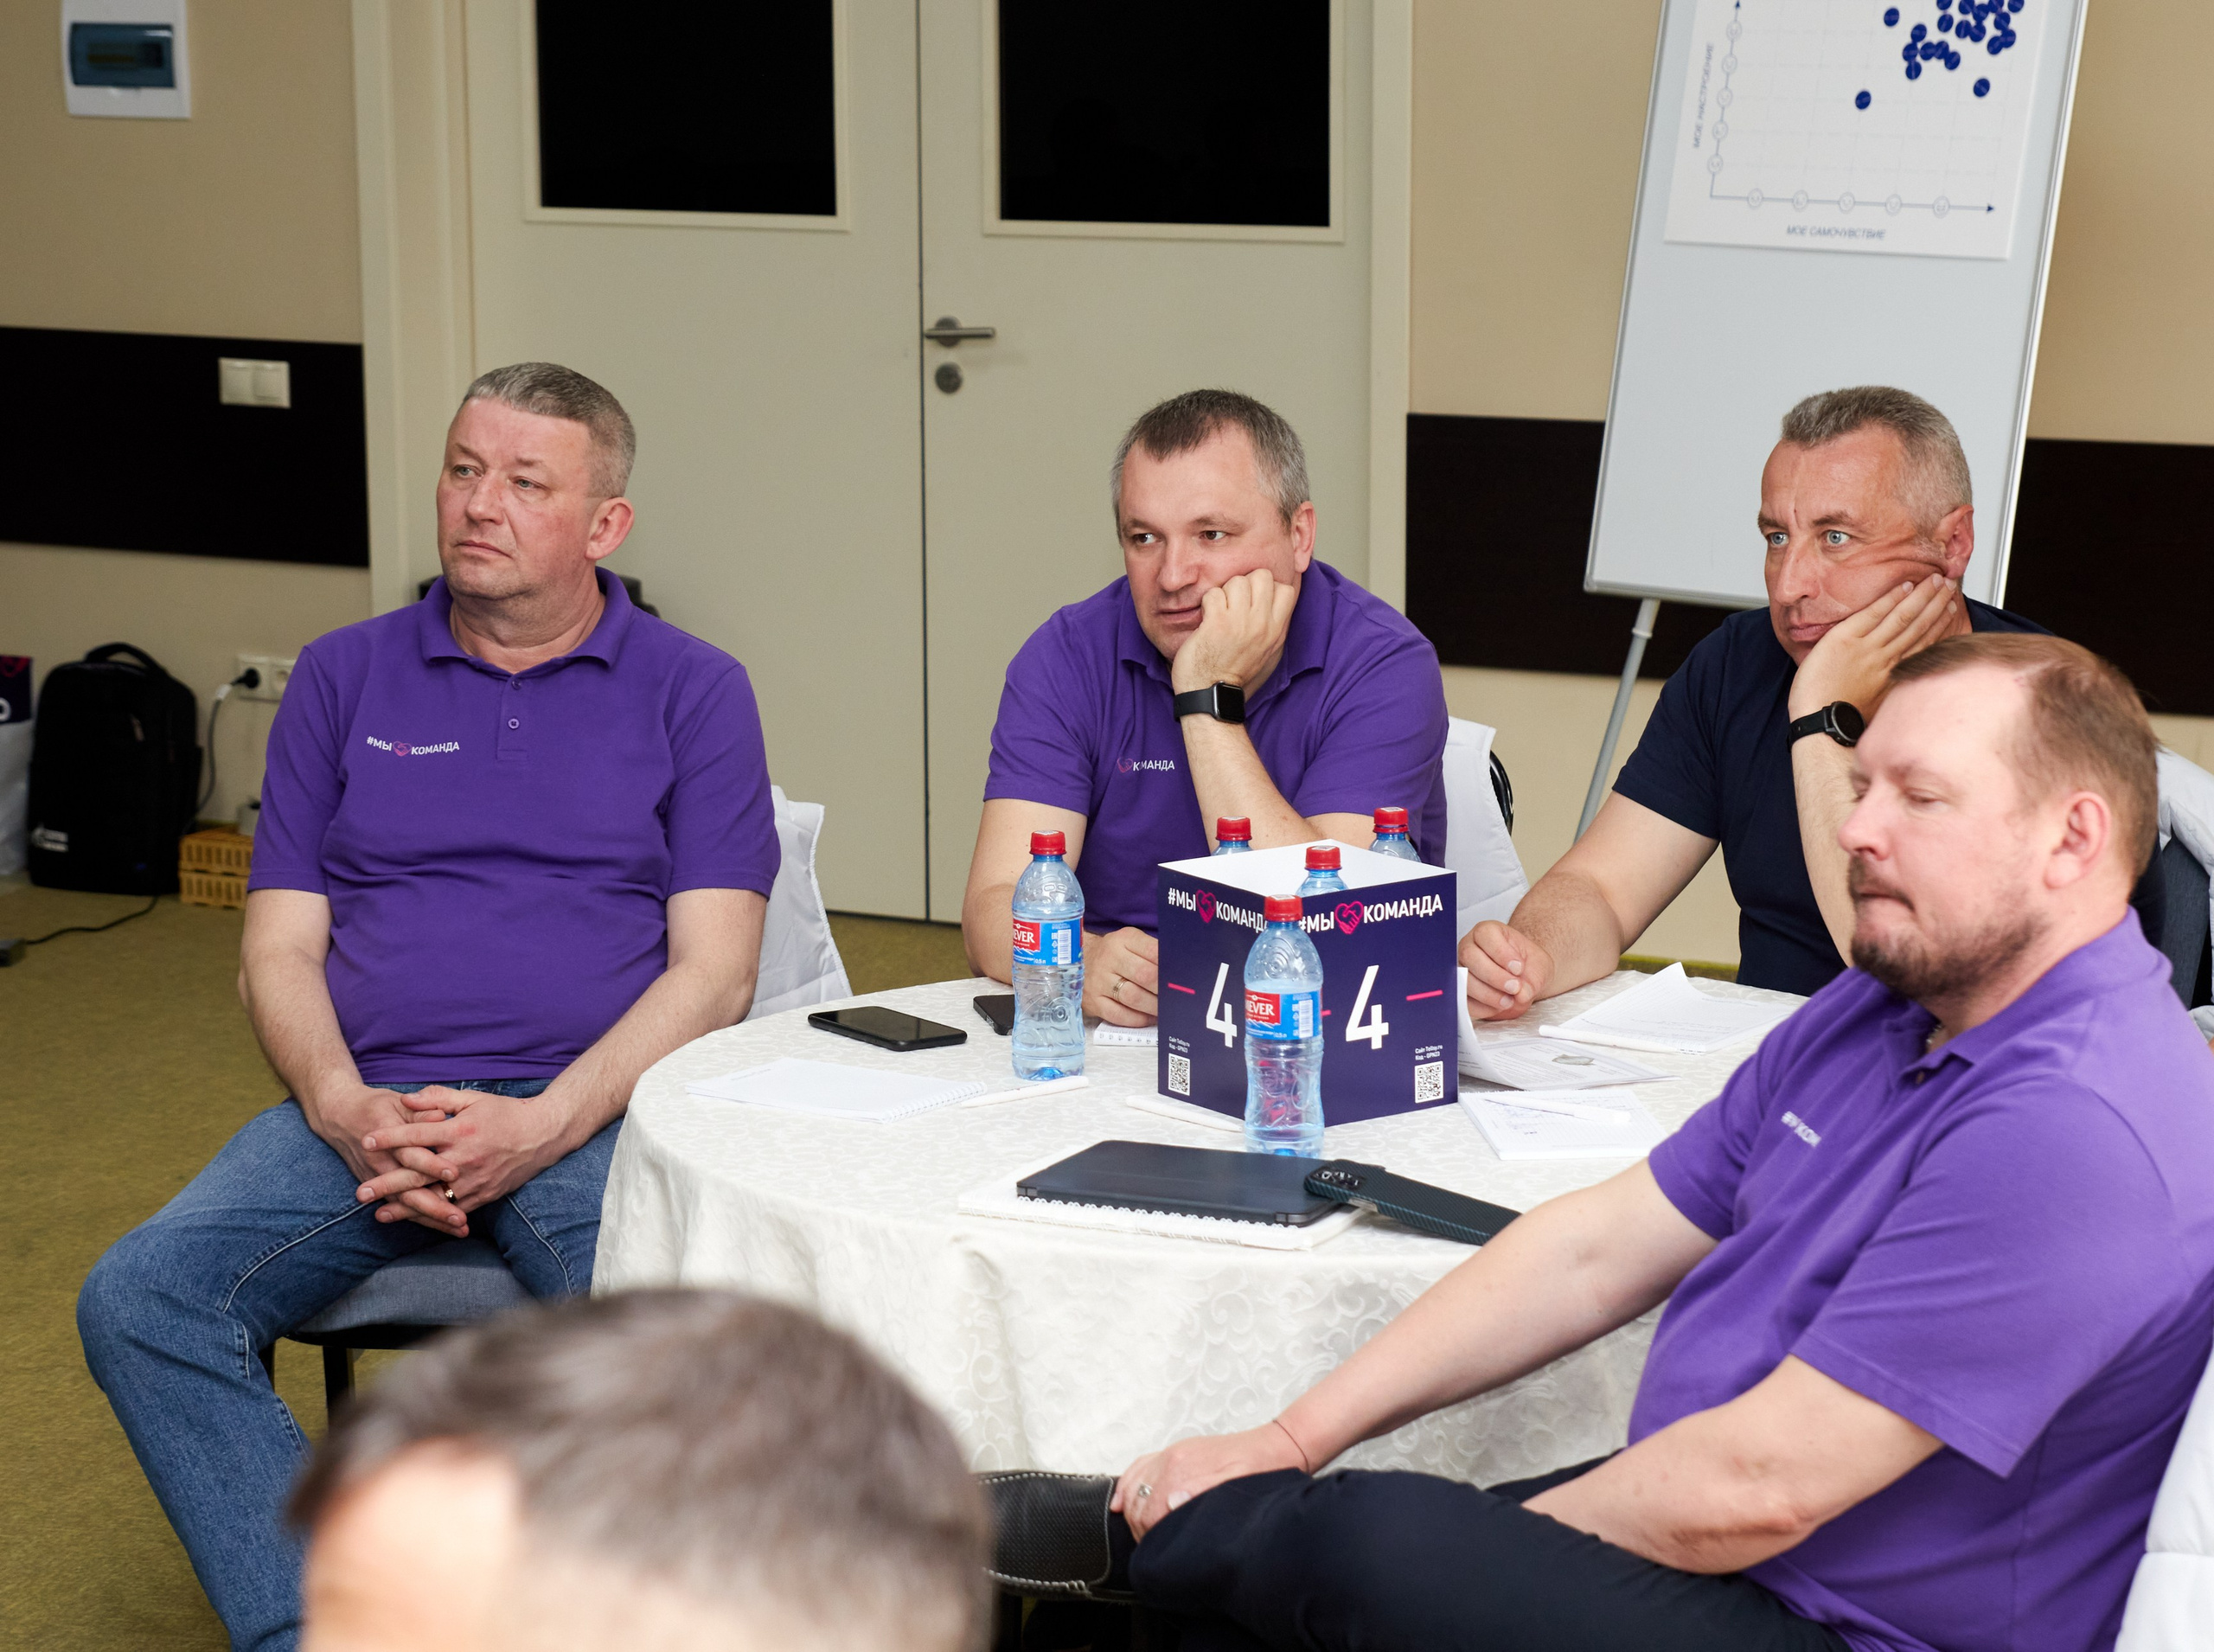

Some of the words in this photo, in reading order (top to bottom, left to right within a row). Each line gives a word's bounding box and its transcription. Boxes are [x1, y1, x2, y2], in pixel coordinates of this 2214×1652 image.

[1810, 226, 1887, 240] САМОЧУВСТВИЕ
[367, 736, 393, 752] #МЫ
[411, 741, 460, 755] КОМАНДА
[1133, 759, 1175, 772] КМАНДА
[1168, 887, 1196, 912] #МЫ
[1363, 893, 1443, 924] КОМАНДА
[1206, 962, 1238, 1048] 4
[1346, 964, 1389, 1050] 4
